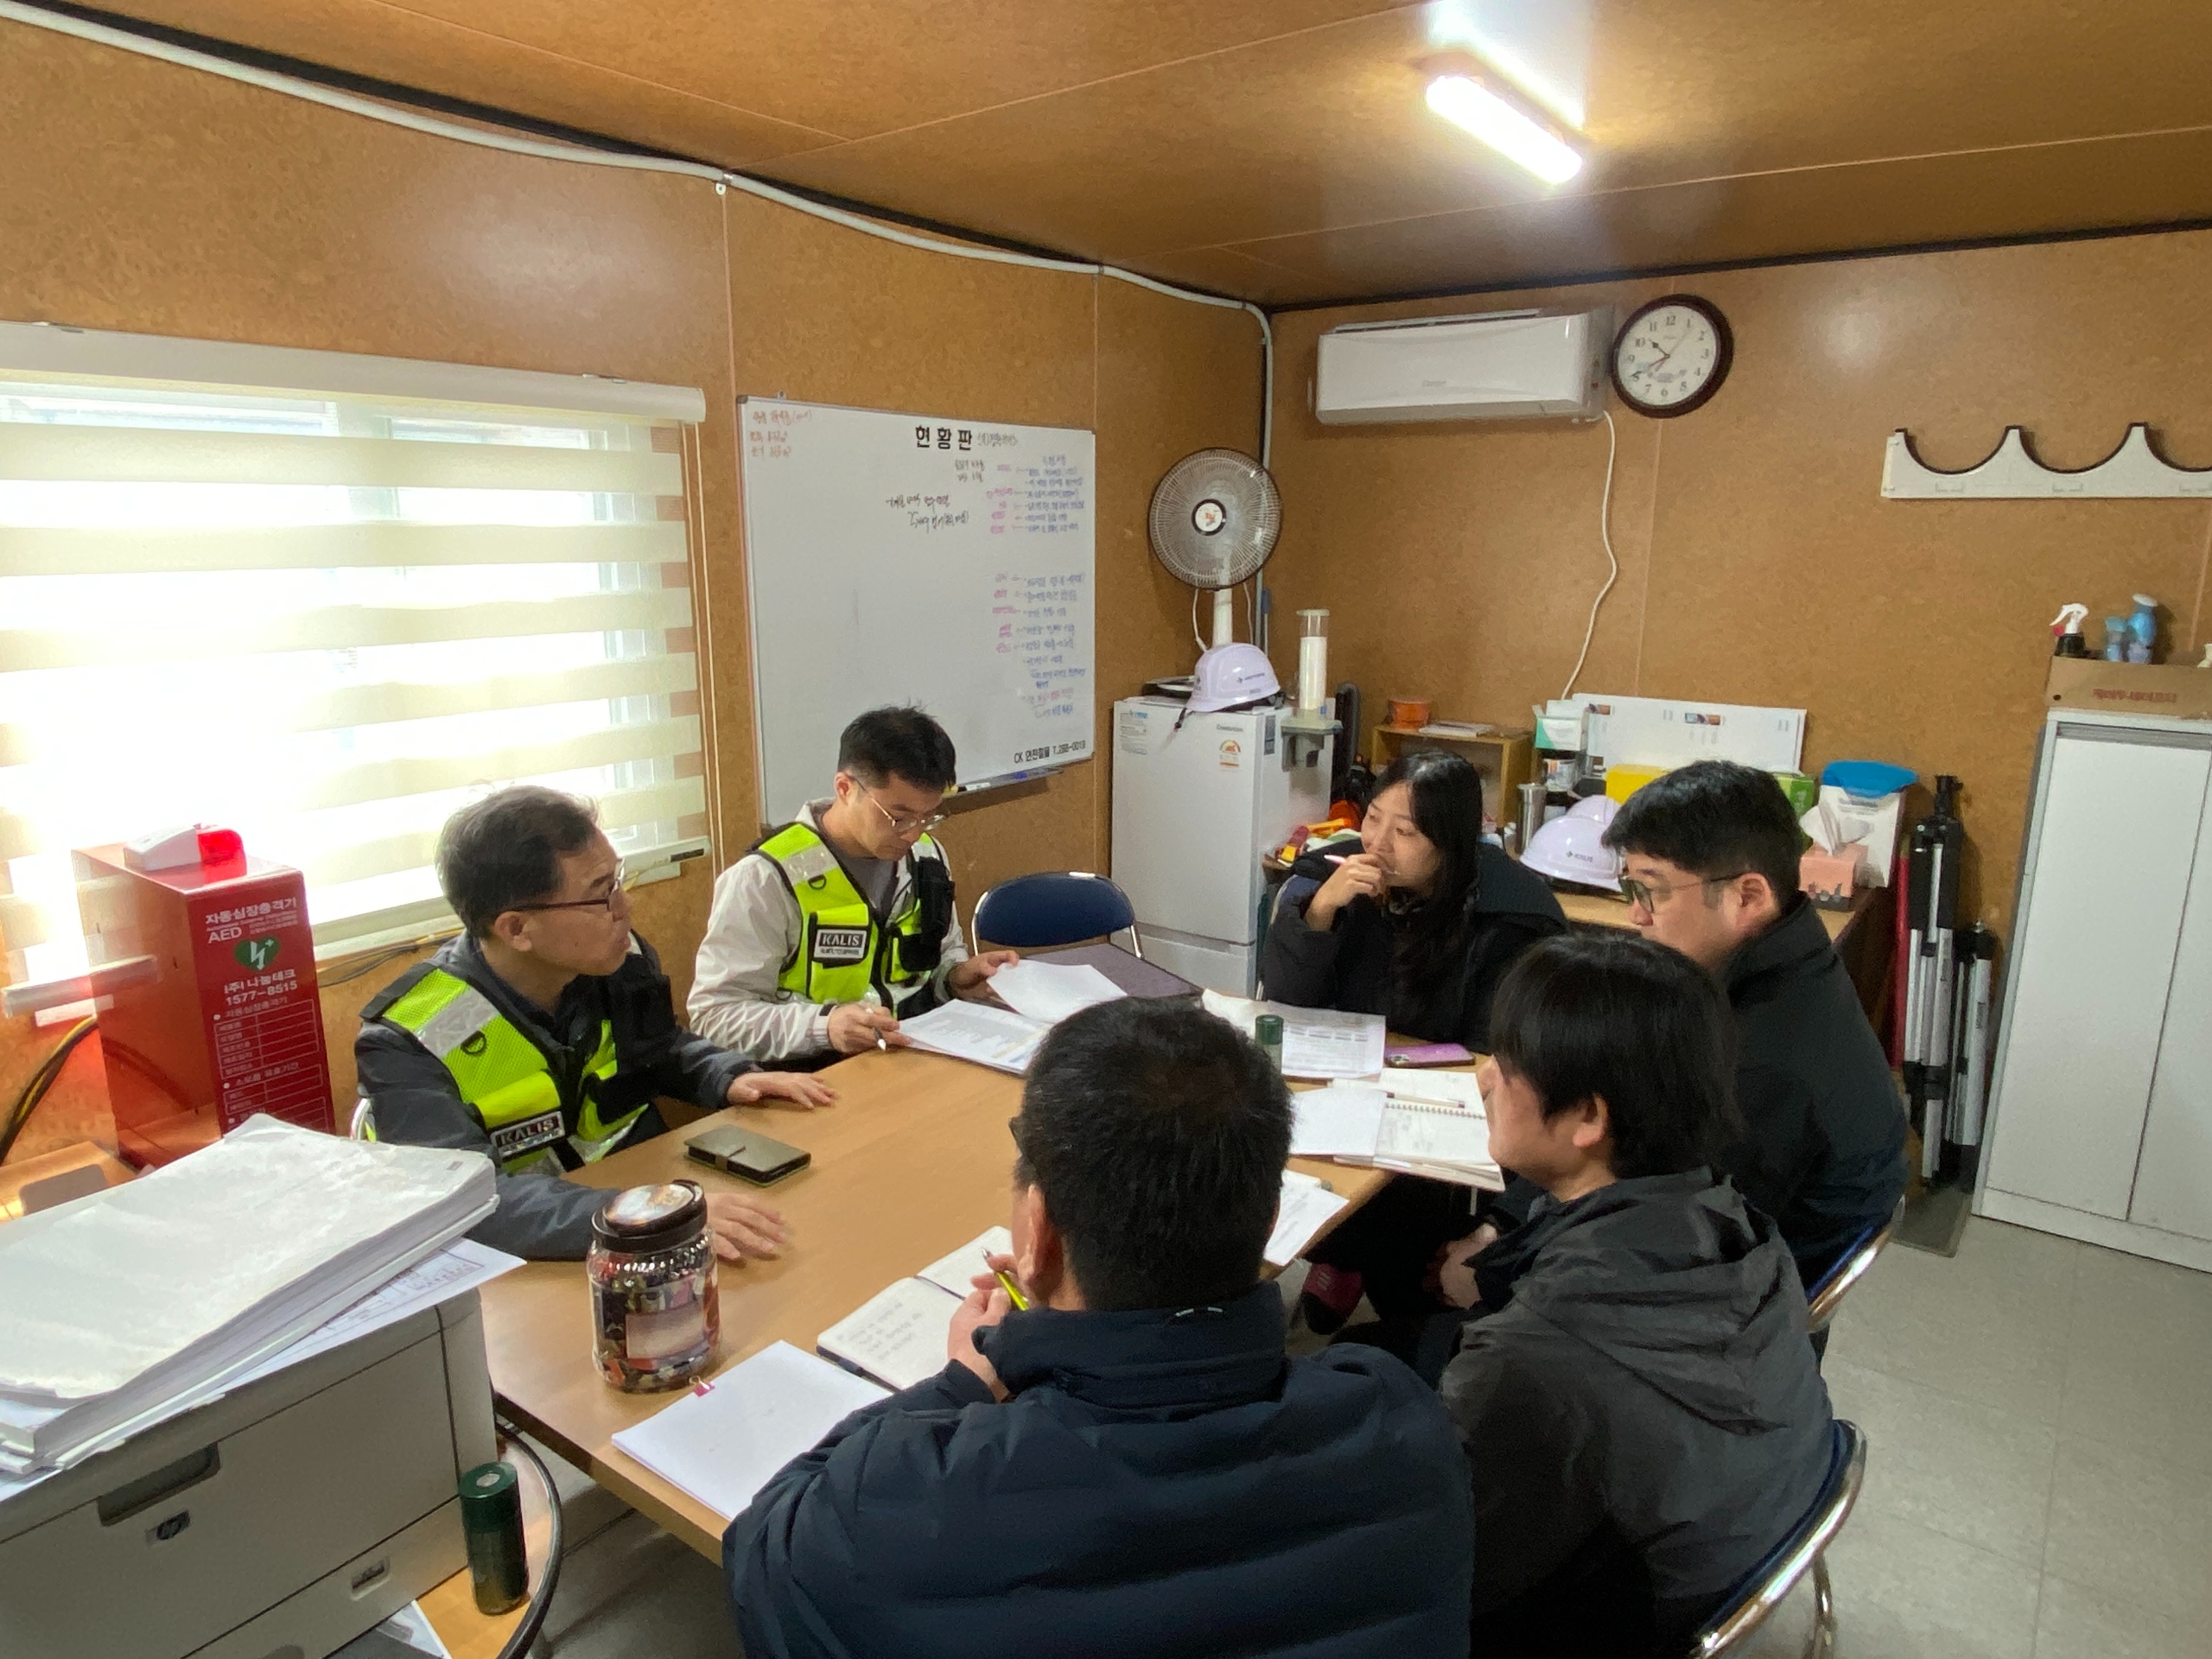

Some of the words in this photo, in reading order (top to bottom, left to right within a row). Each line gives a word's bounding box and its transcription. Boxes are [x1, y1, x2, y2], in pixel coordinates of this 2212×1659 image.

[1666, 315, 1676, 326] 12
[1649, 321, 1657, 332] 11
[1698, 331, 1705, 341] 2
[1635, 337, 1646, 347] 10
[1627, 354, 1635, 363] 9
[1700, 348, 1709, 359] 3
[1661, 388, 1669, 397] 6
[1679, 382, 1688, 392] 5
[205, 897, 296, 925] 자동심장충격기
[207, 926, 243, 944] AED
[822, 934, 860, 946] KALIS
[226, 980, 298, 1006] 1577-8515
[501, 1119, 554, 1145] KALIS
